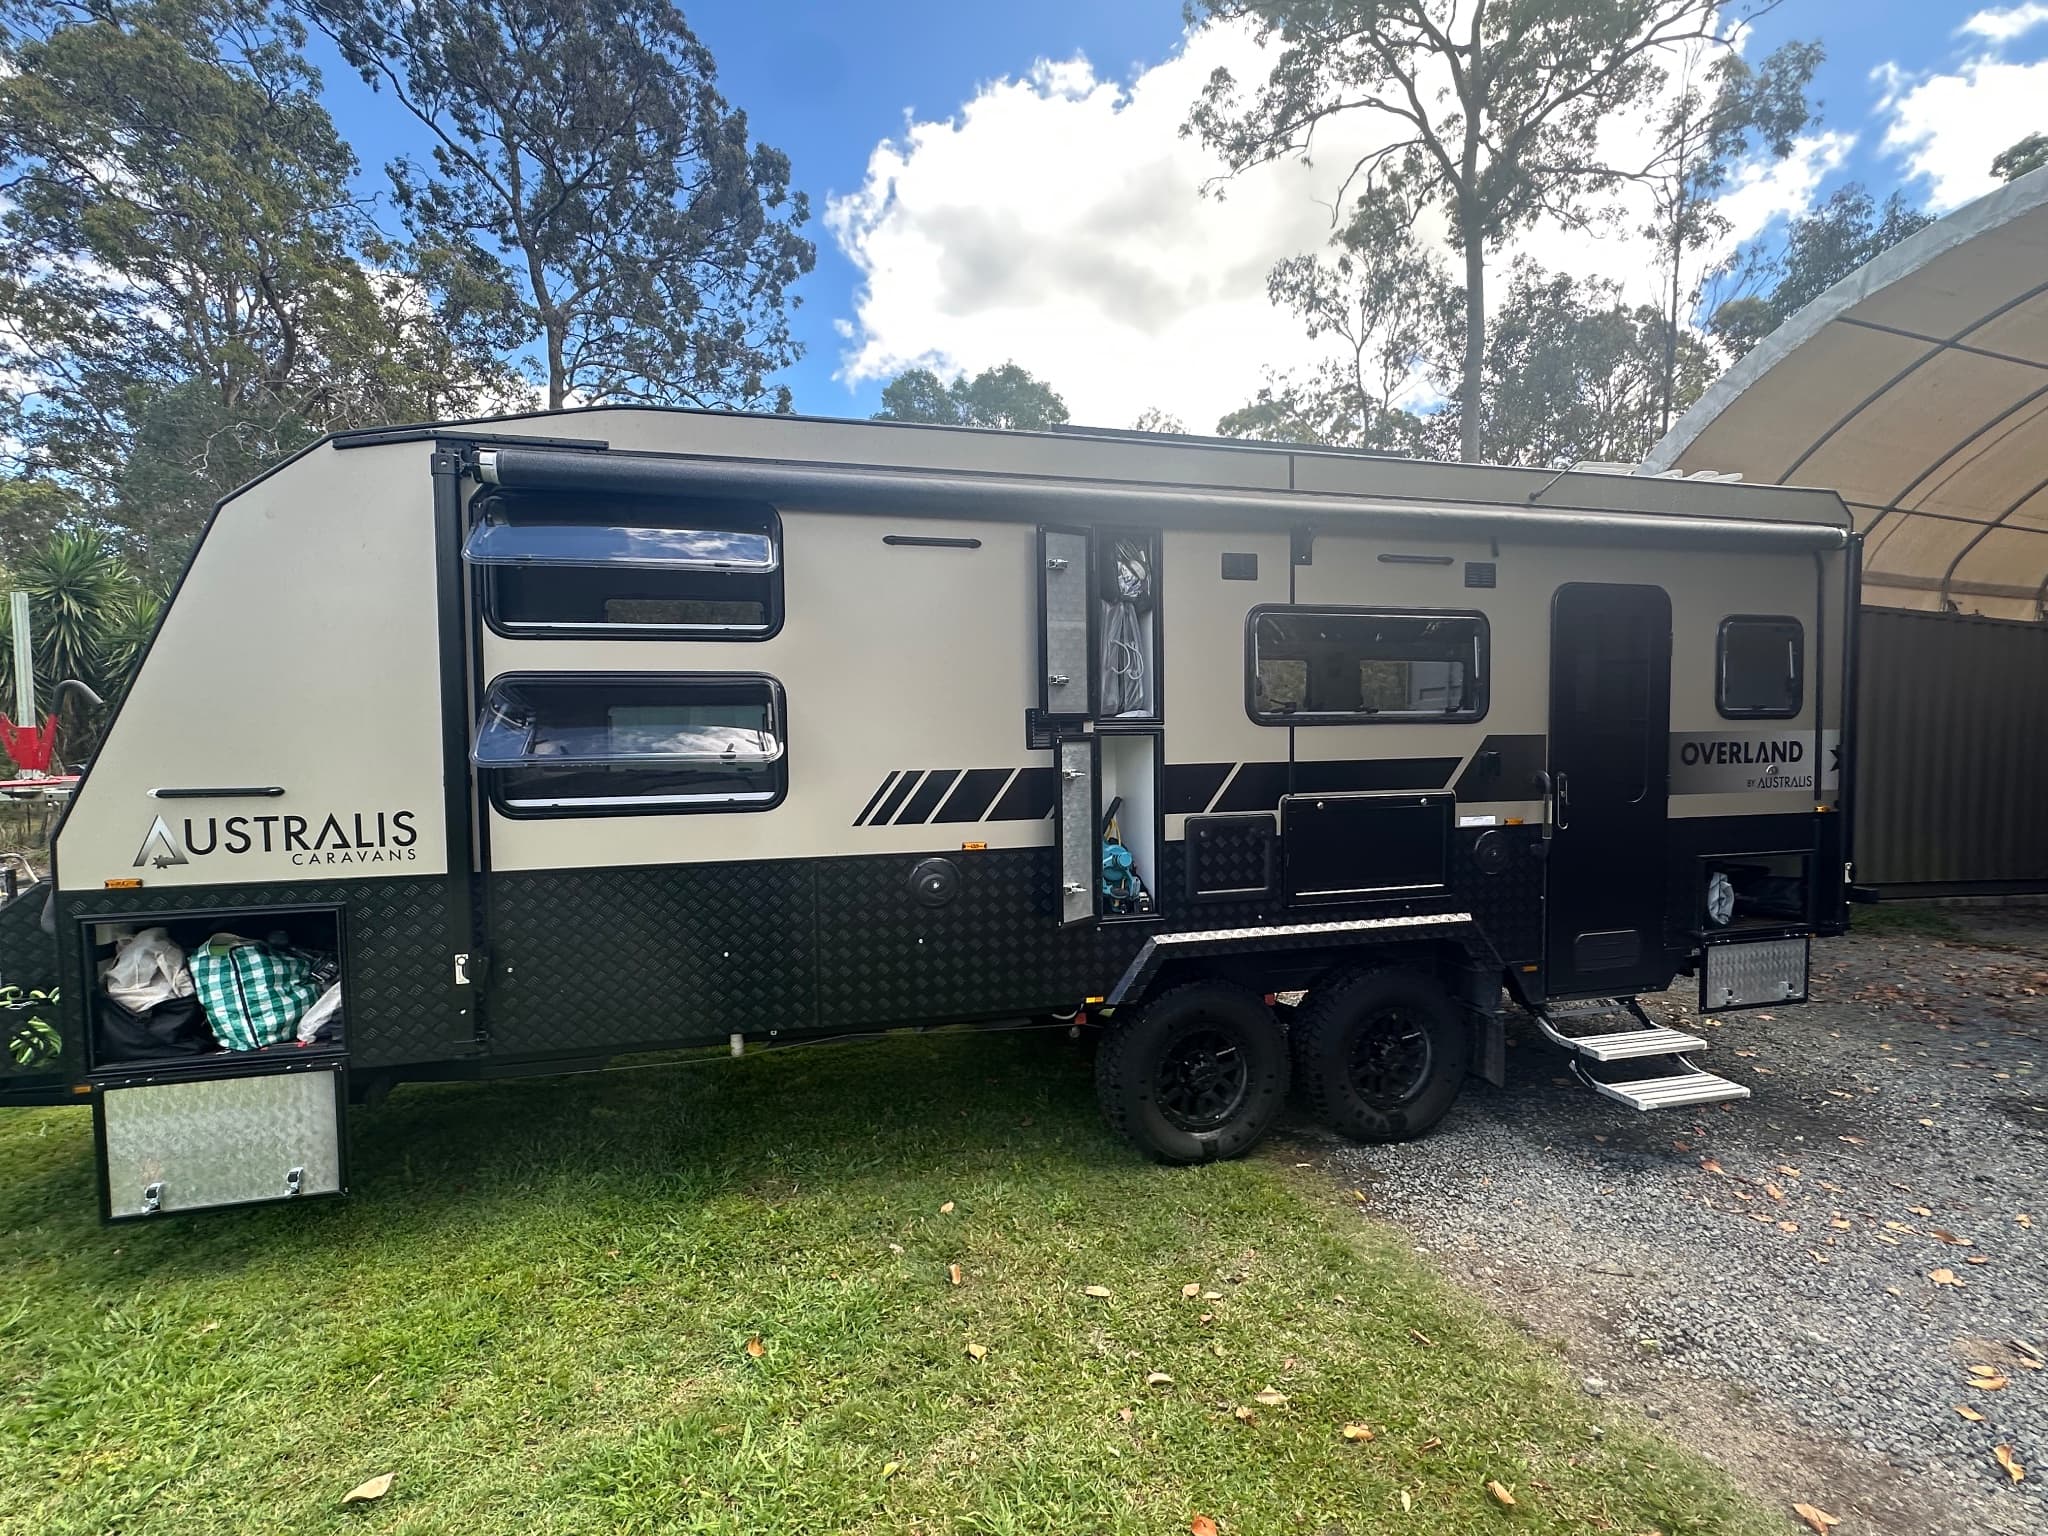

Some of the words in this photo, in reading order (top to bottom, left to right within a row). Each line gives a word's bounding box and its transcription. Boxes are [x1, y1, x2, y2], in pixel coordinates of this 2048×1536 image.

[1681, 741, 1803, 766] OVERLAND
[1758, 776, 1813, 789] AUSTRALIS
[132, 810, 418, 869] AUSTRALIS
[291, 848, 417, 866] CARAVANS
